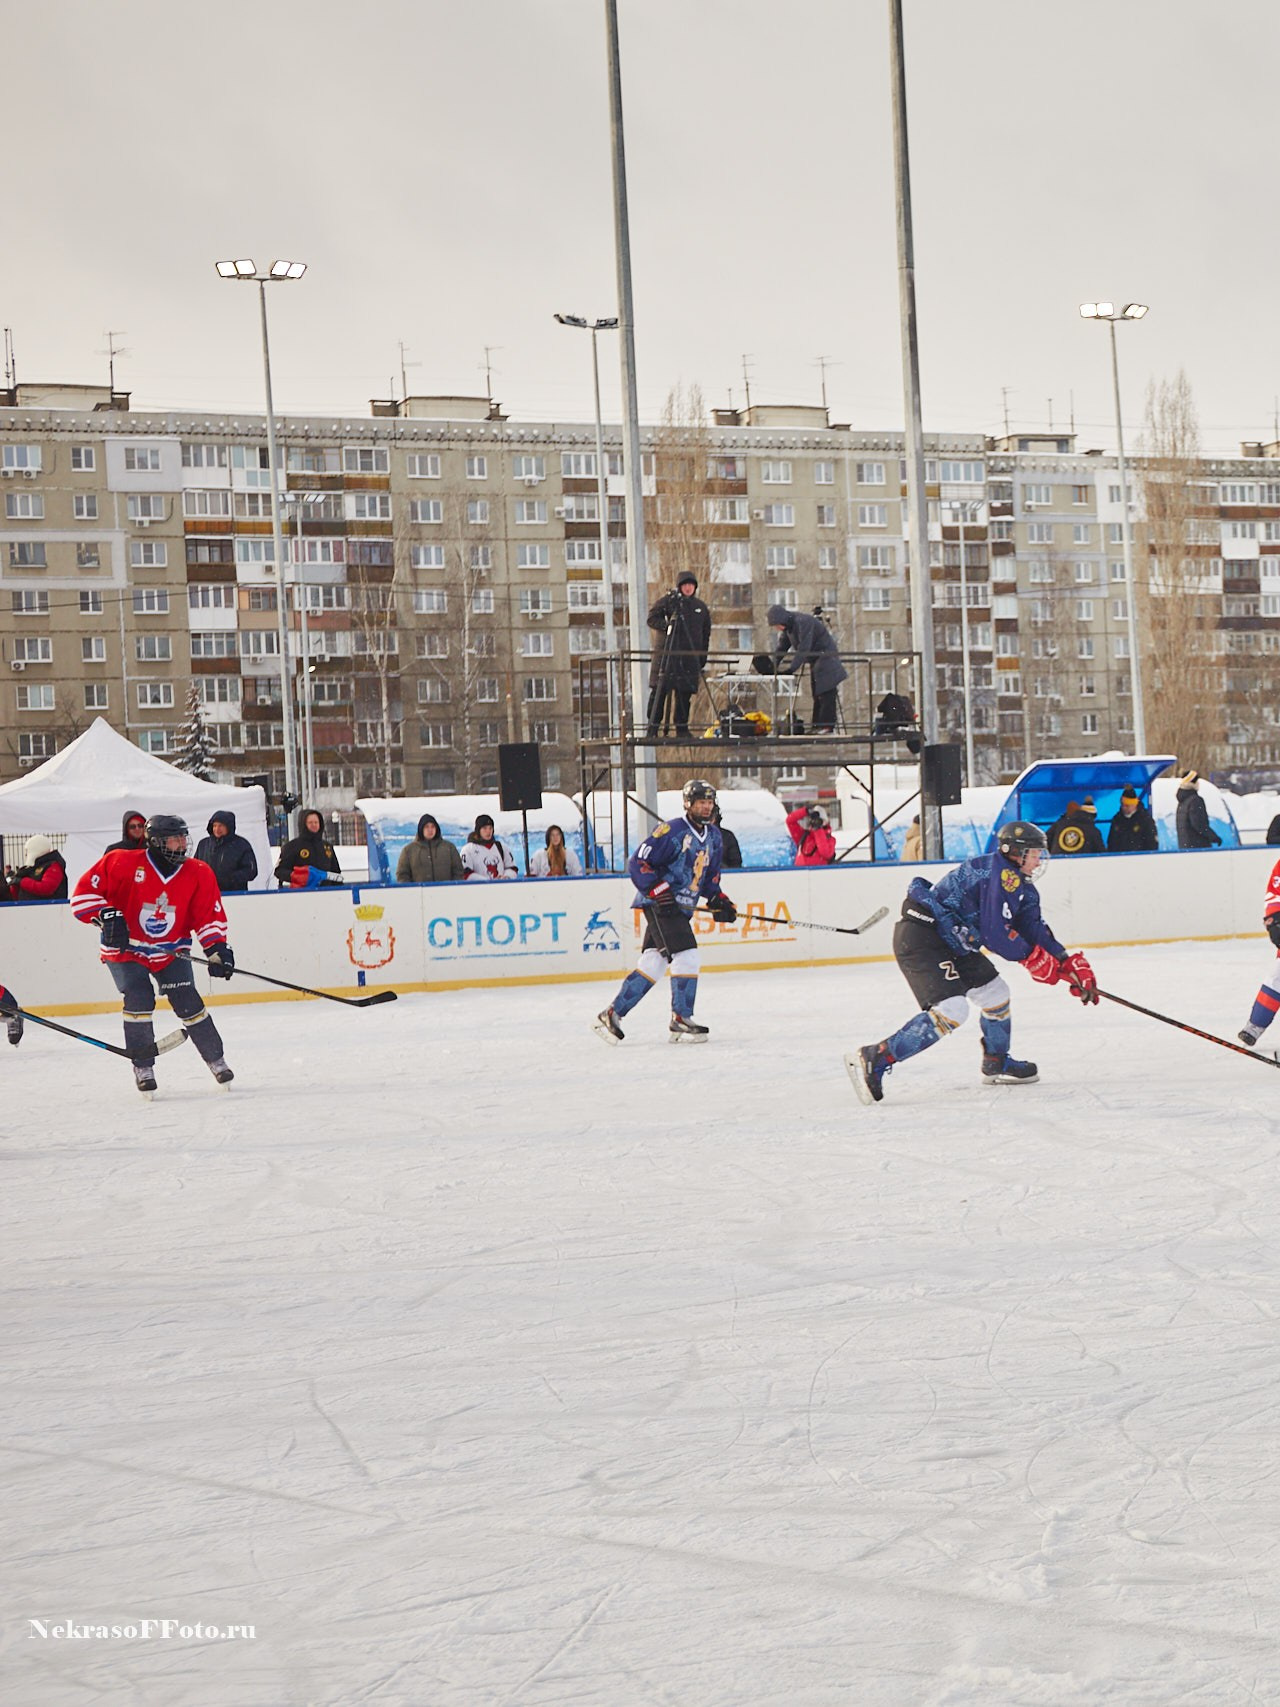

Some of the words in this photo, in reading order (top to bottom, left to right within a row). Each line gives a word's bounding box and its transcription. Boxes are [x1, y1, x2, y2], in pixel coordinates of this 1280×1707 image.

[633, 900, 795, 939] БЕДА
[1001, 902, 1012, 920] 6
[428, 912, 567, 948] СПОРТ
[582, 941, 621, 952] ГАЗ
[939, 961, 960, 981] Z
